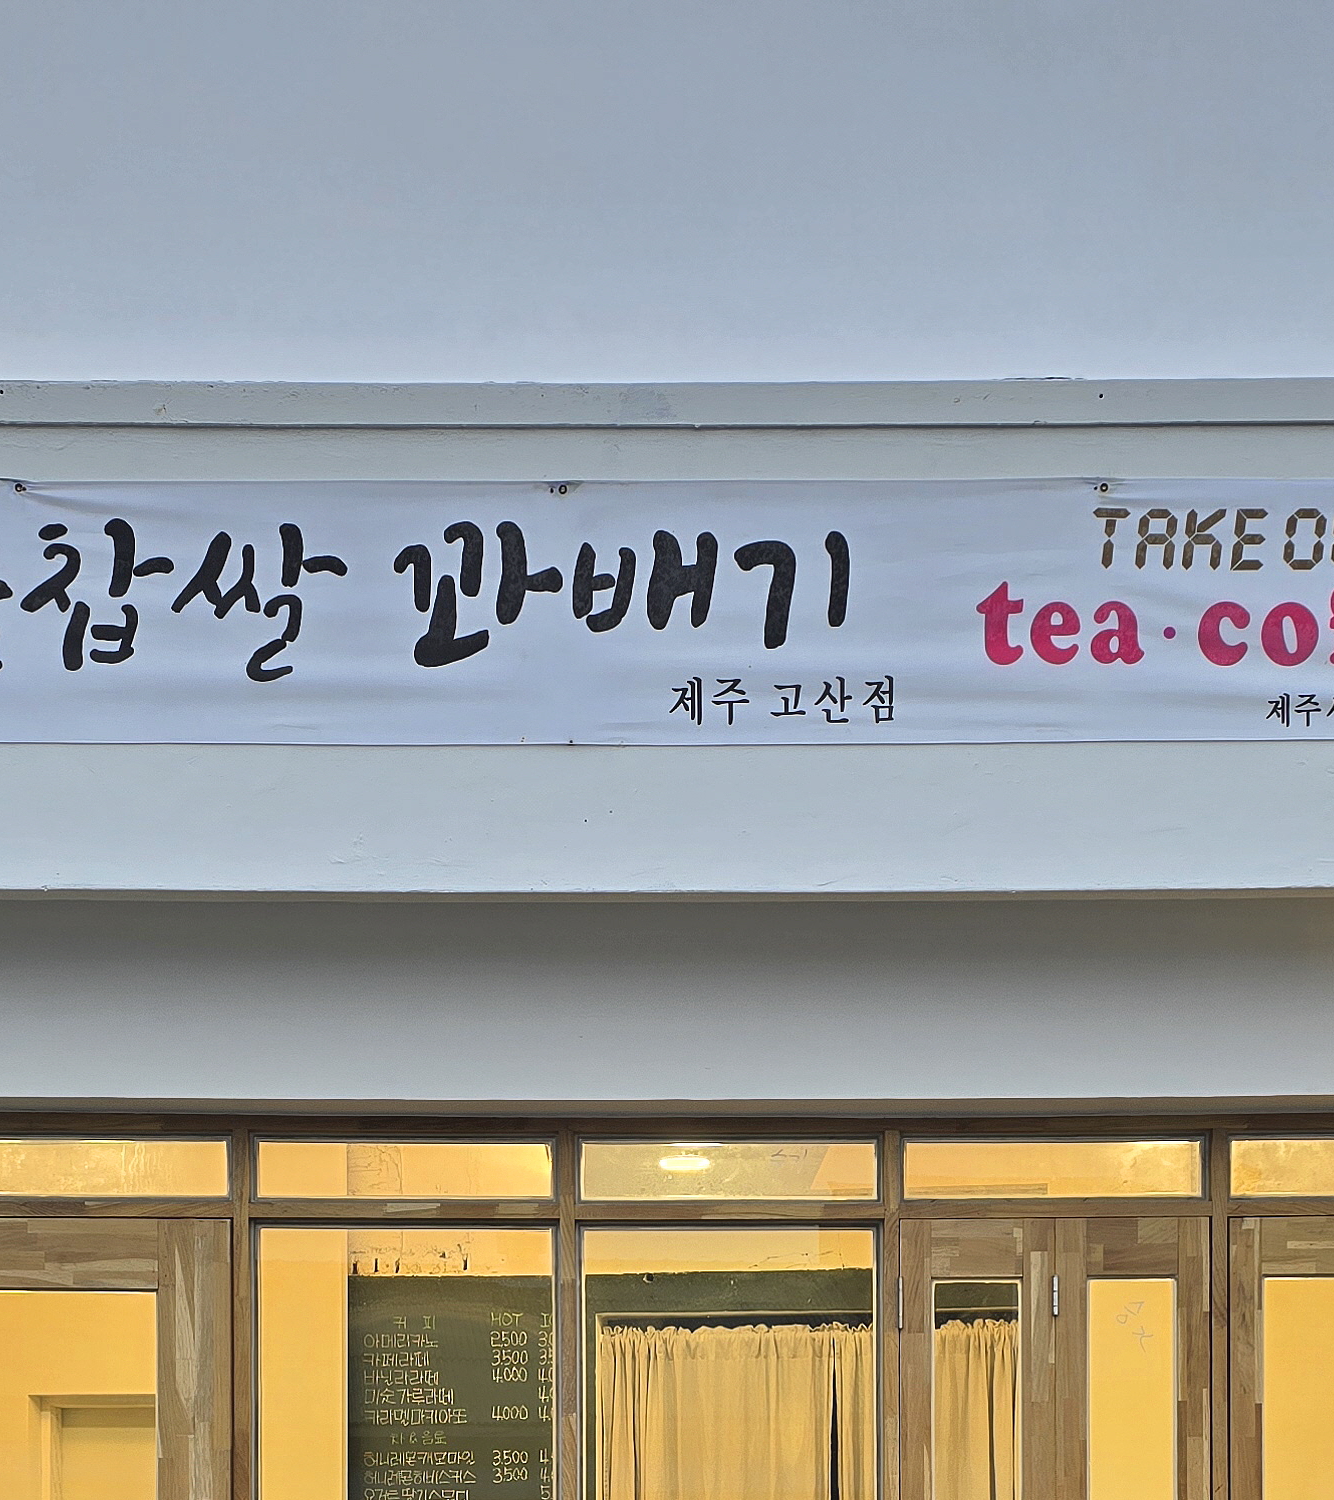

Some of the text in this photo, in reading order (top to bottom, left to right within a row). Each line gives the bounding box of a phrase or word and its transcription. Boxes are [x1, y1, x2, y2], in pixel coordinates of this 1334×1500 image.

[1092, 506, 1269, 572] TAKE
[392, 519, 851, 669] 꽈배기
[975, 580, 1146, 667] tea
[668, 675, 897, 726] 제주 고산점
[363, 1333, 439, 1349] 아메리카노
[490, 1311, 524, 1327] HOT
